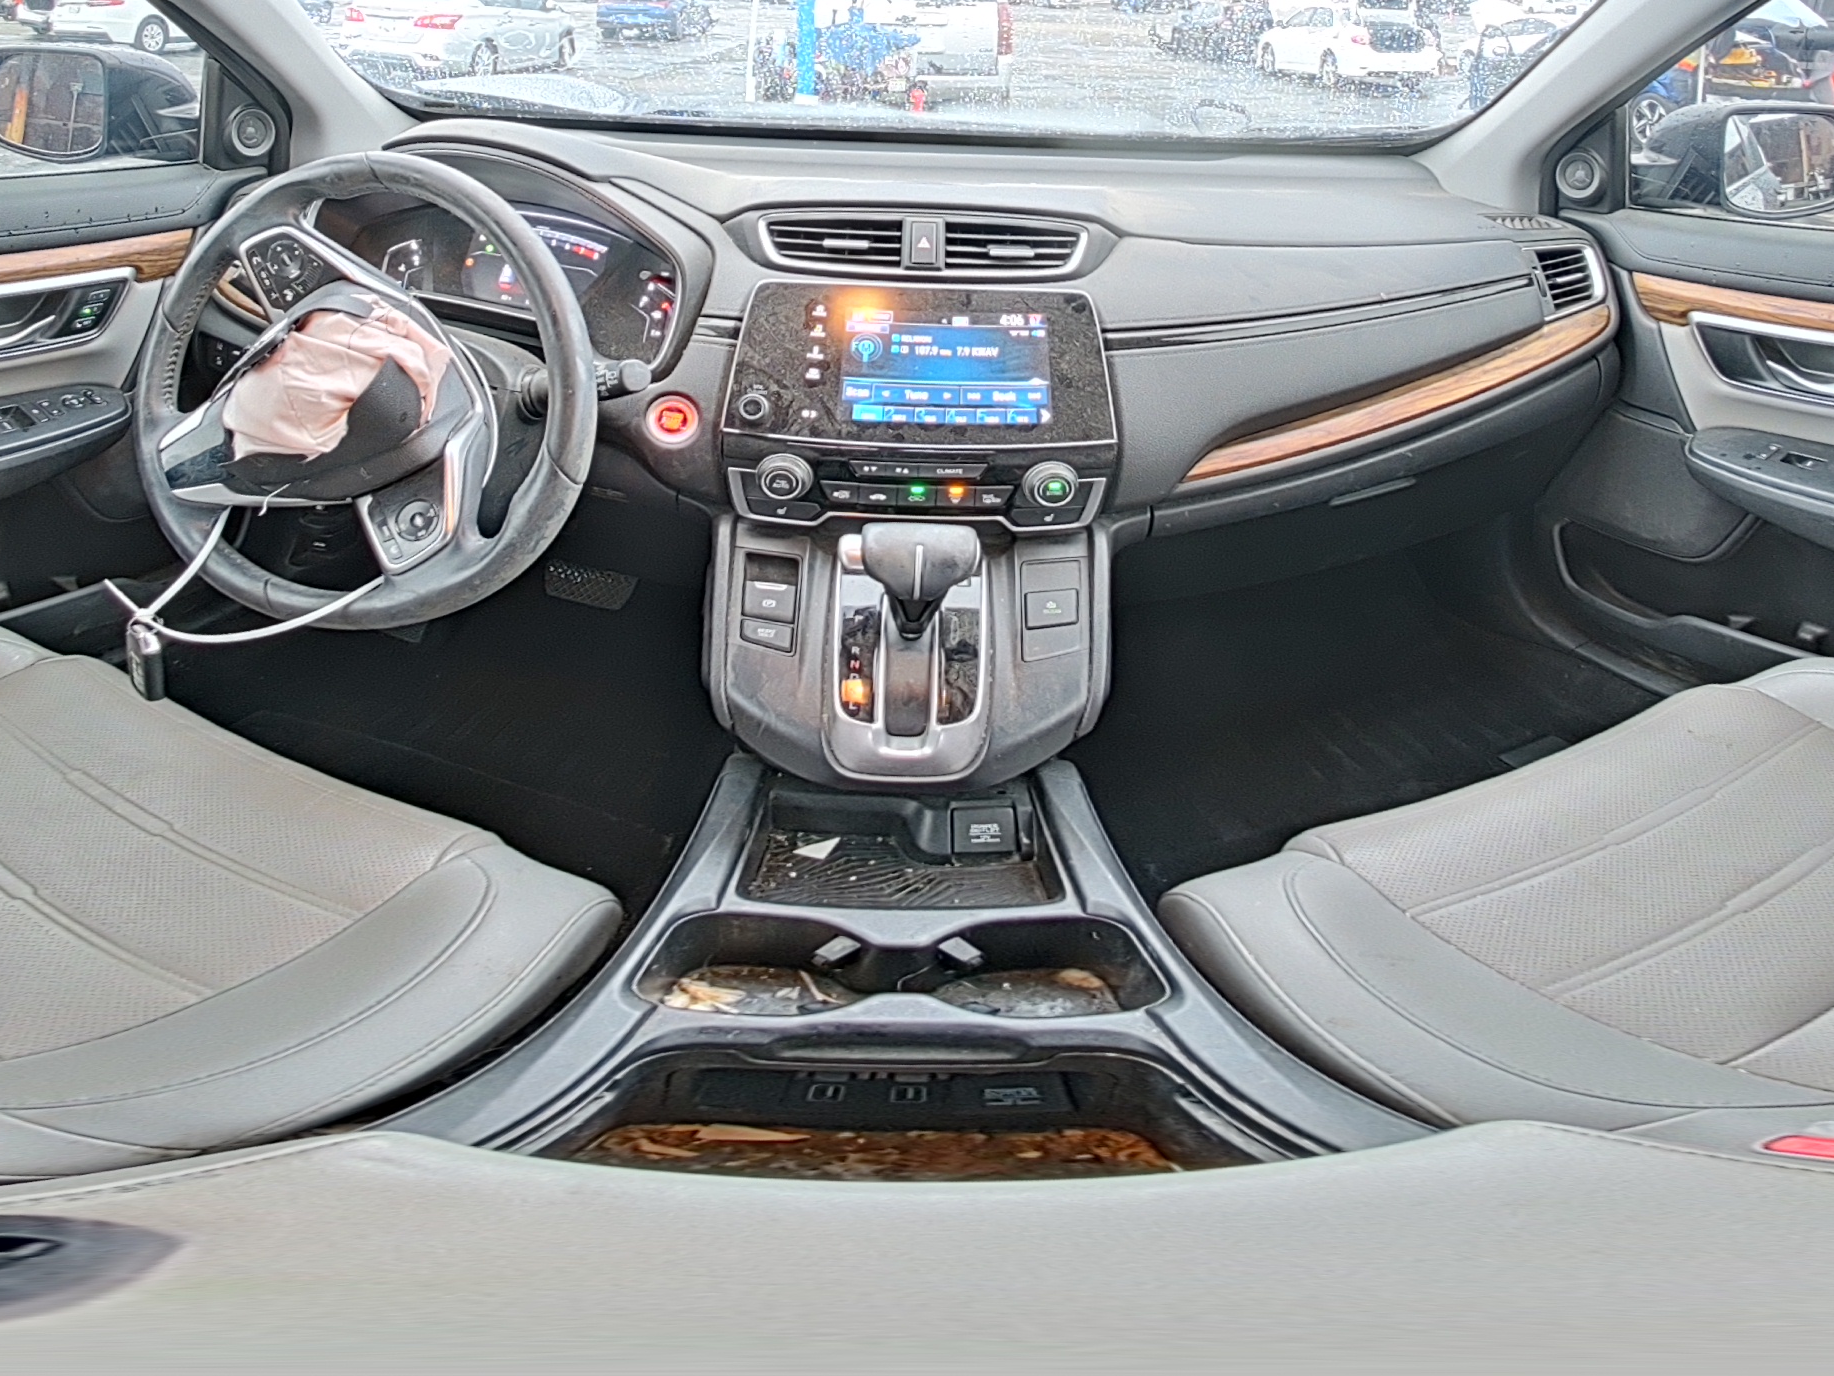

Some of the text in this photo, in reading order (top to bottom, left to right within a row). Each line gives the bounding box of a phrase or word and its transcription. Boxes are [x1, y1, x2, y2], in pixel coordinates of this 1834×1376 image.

[1000, 314, 1025, 326] 4:06
[845, 387, 870, 397] Scan
[904, 389, 929, 400] Tune
[936, 467, 963, 475] CLIMATE
[852, 646, 860, 655] R
[850, 660, 860, 669] N
